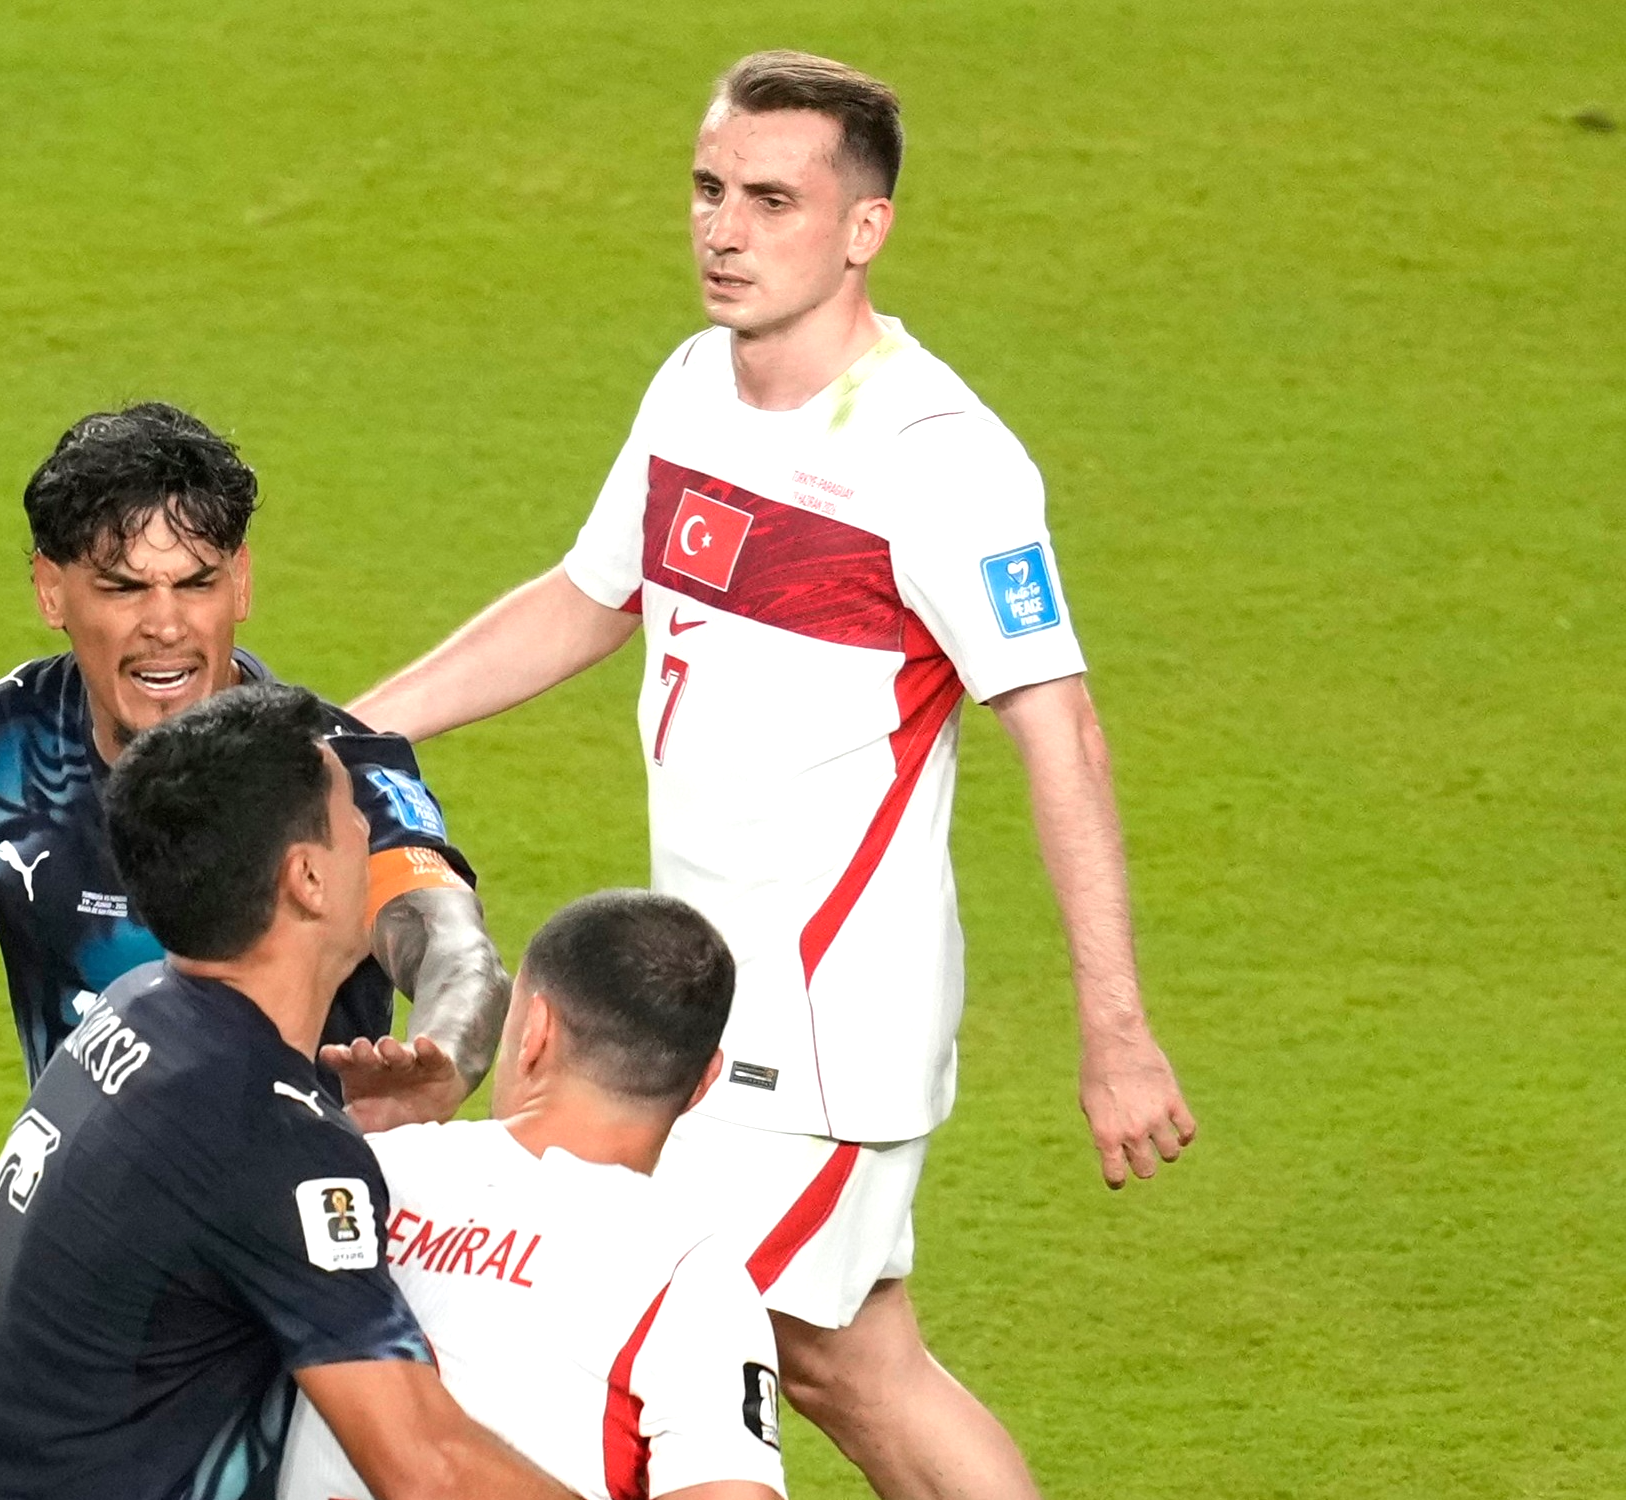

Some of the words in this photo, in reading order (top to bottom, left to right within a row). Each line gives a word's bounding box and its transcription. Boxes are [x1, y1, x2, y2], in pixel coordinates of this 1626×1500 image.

[1010, 597, 1044, 619] PEACE
[654, 653, 689, 767] 7
[387, 1208, 543, 1289] EMİRAL
